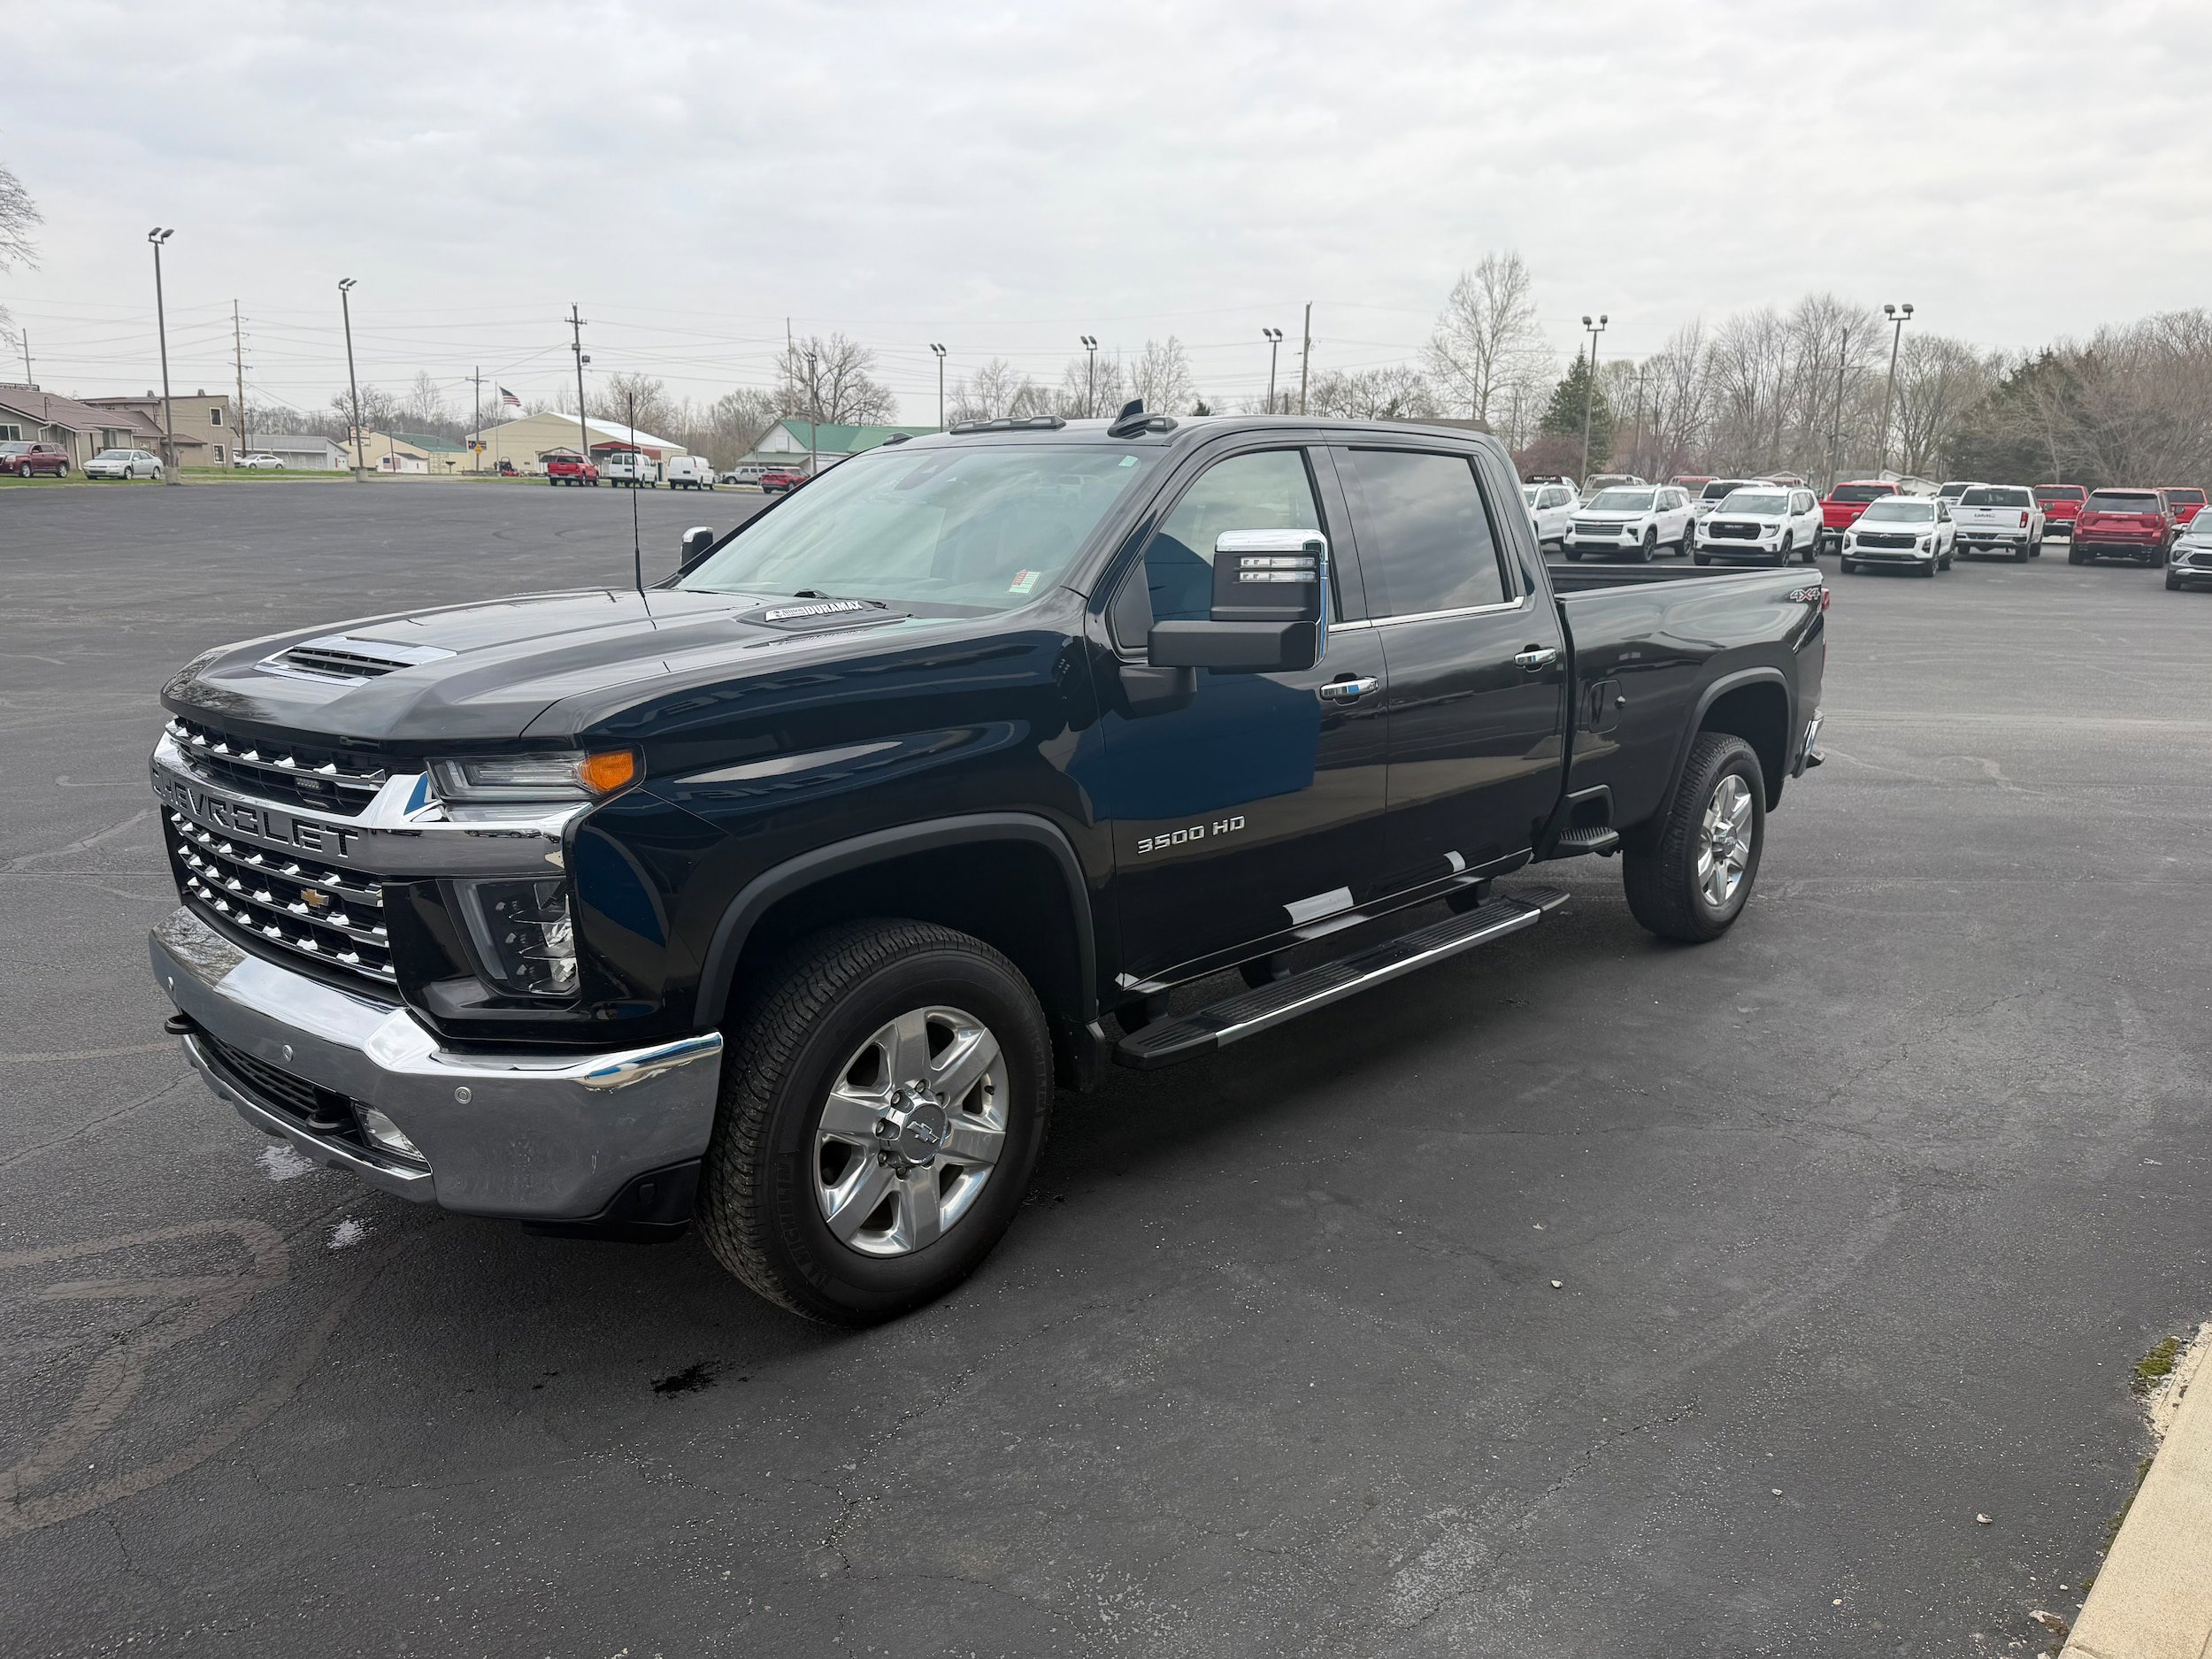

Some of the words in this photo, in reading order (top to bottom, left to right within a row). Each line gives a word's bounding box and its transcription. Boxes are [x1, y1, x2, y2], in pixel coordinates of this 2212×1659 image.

[804, 601, 863, 615] DURAMAX
[152, 767, 358, 857] CHEVROLET
[1137, 826, 1204, 854] 3500
[1212, 816, 1245, 836] HD
